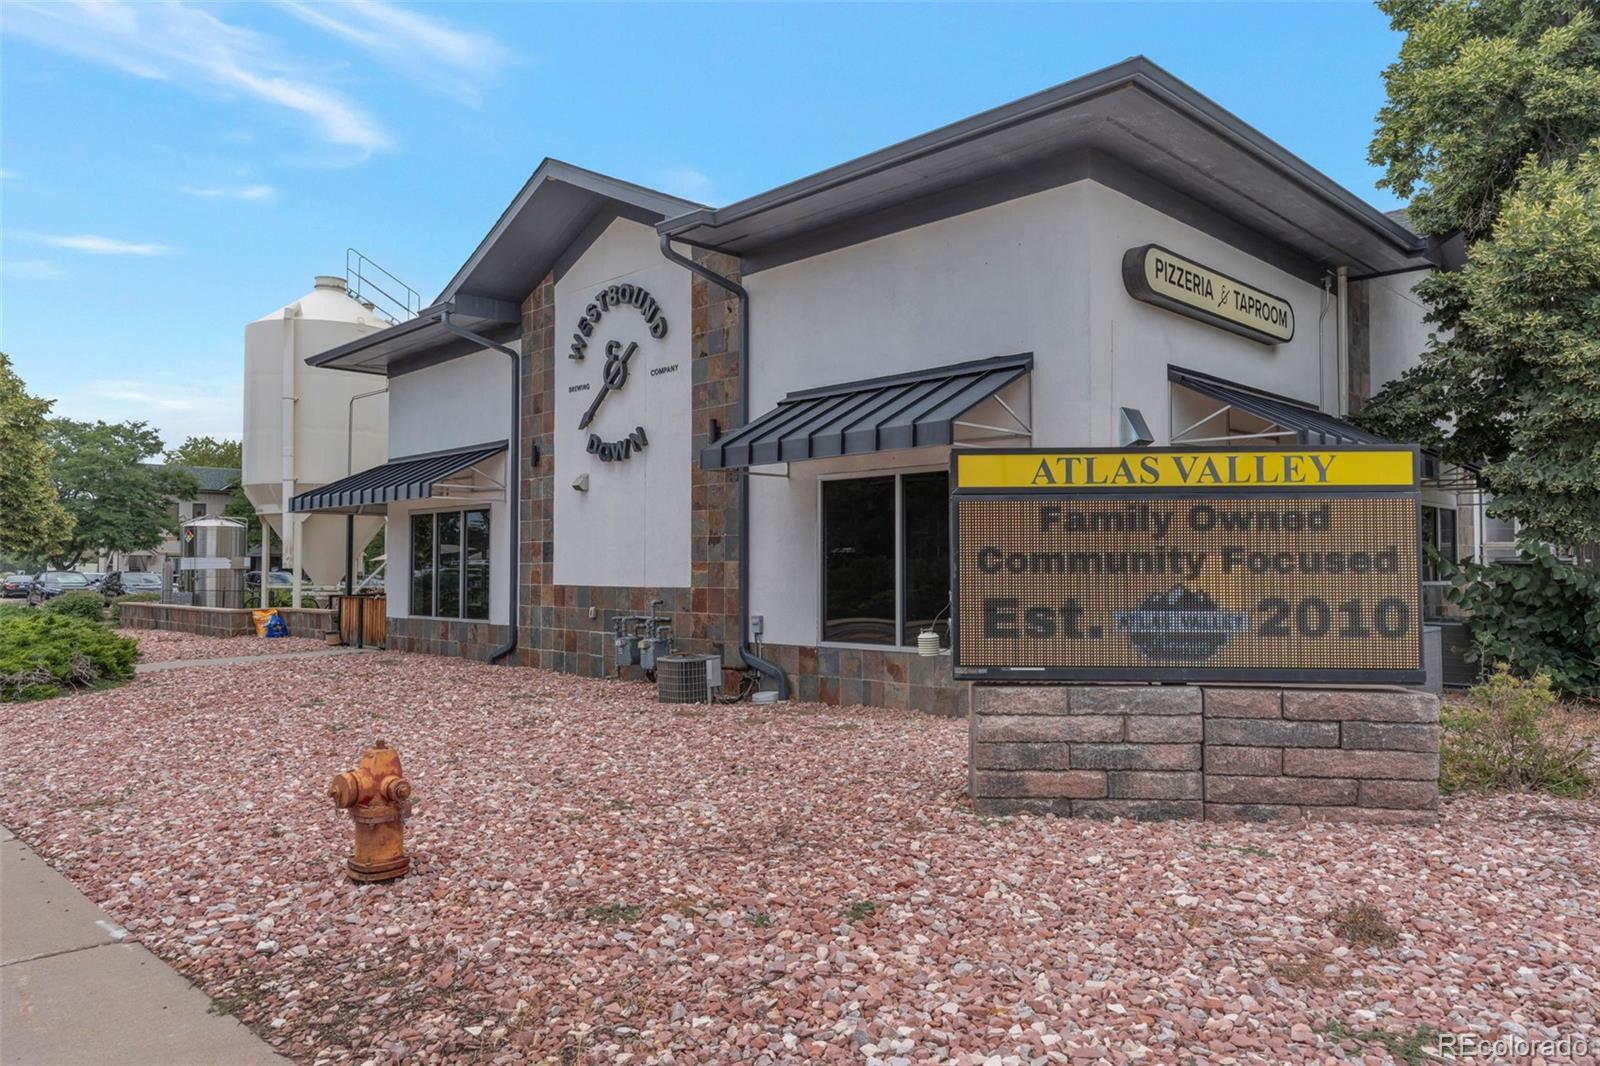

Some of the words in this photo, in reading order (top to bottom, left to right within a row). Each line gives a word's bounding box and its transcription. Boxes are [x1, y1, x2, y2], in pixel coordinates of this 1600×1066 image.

[1155, 257, 1215, 301] PIZZERIA
[1233, 290, 1288, 329] TAPROOM
[567, 283, 669, 361] WESTBOUND
[568, 383, 591, 393] BREWING
[650, 364, 679, 377] COMPANY
[586, 426, 649, 462] DOWN
[1030, 455, 1161, 485] ATLAS
[1171, 454, 1337, 484] VALLEY
[1040, 504, 1174, 540] Family
[1188, 503, 1332, 532] Owned
[978, 545, 1206, 582] Community
[1220, 544, 1399, 575] Focused
[983, 598, 1104, 640] Est.
[1257, 597, 1411, 639] 2010
